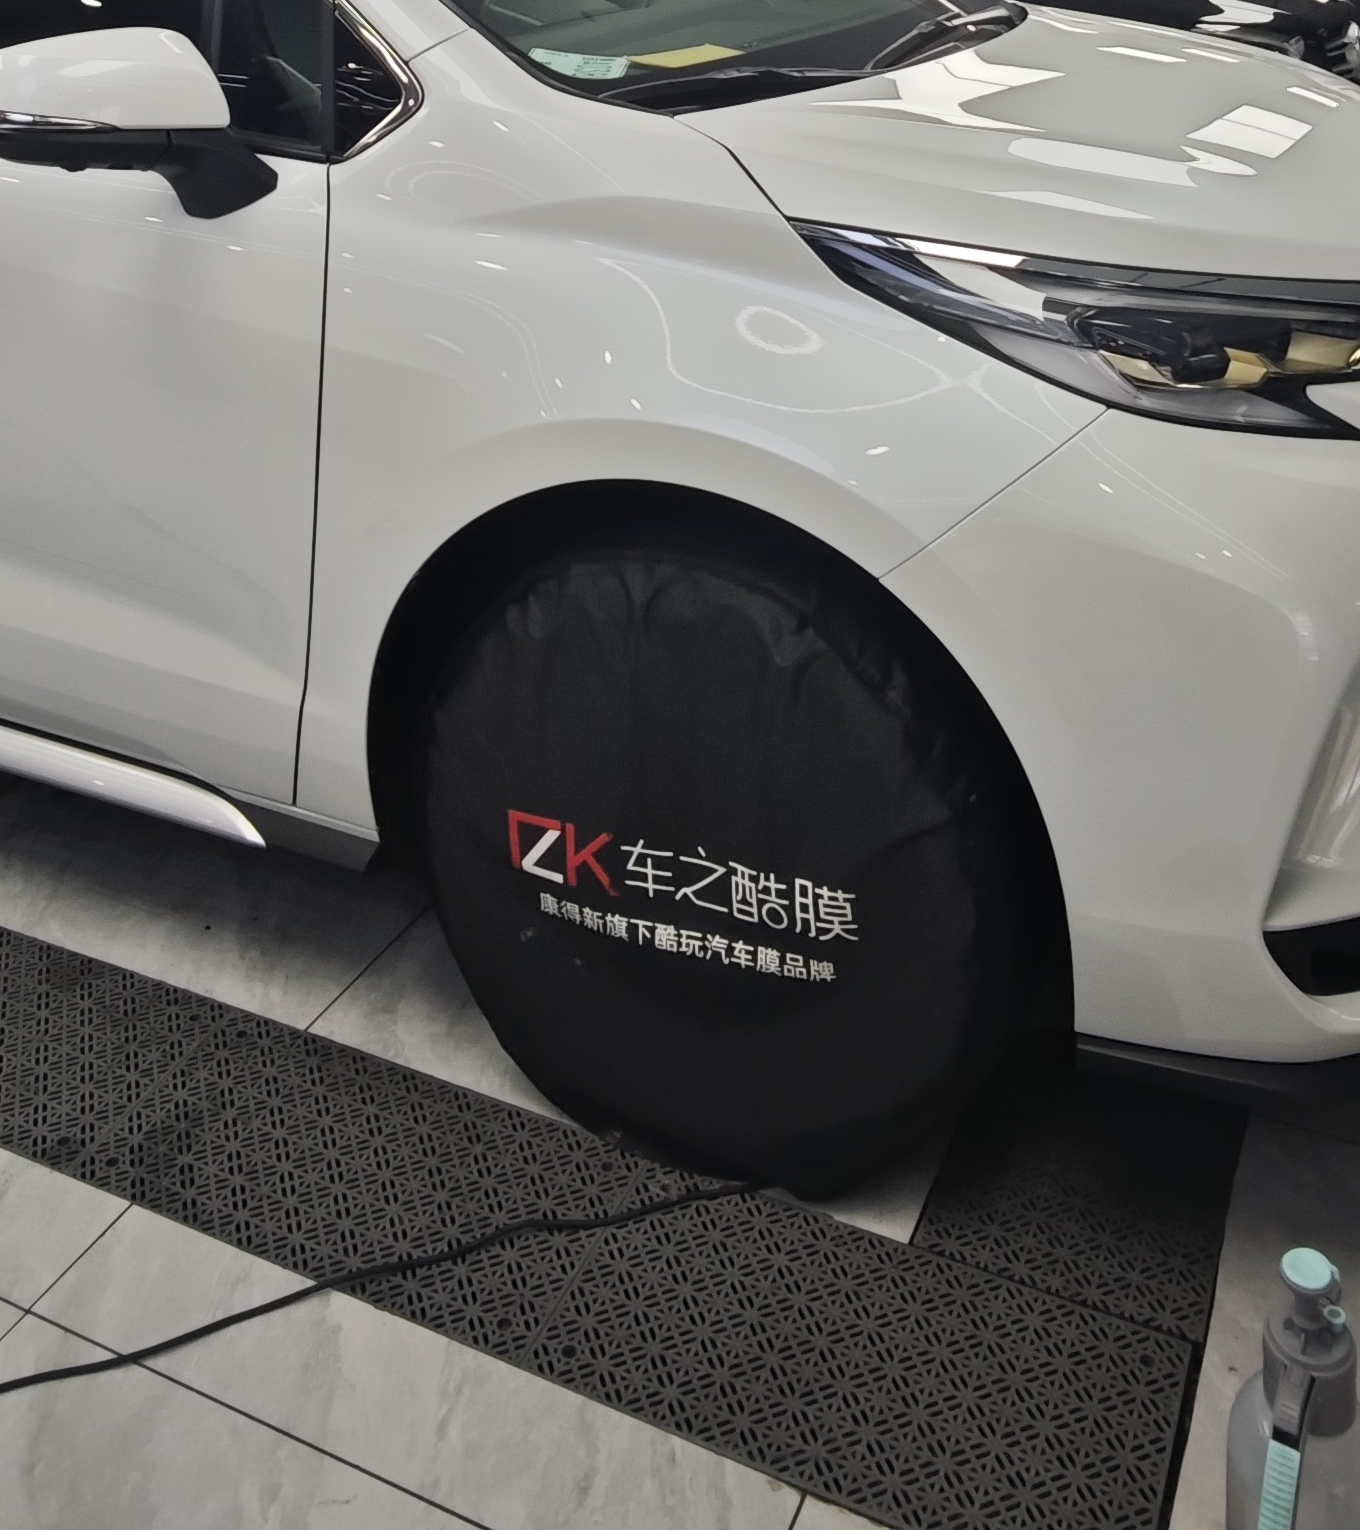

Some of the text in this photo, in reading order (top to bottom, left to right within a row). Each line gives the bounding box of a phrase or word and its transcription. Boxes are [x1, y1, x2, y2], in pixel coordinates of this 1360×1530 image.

[539, 892, 837, 983] 康得新旗下酷玩汽车膜品牌
[620, 838, 859, 942] 车之酷膜
